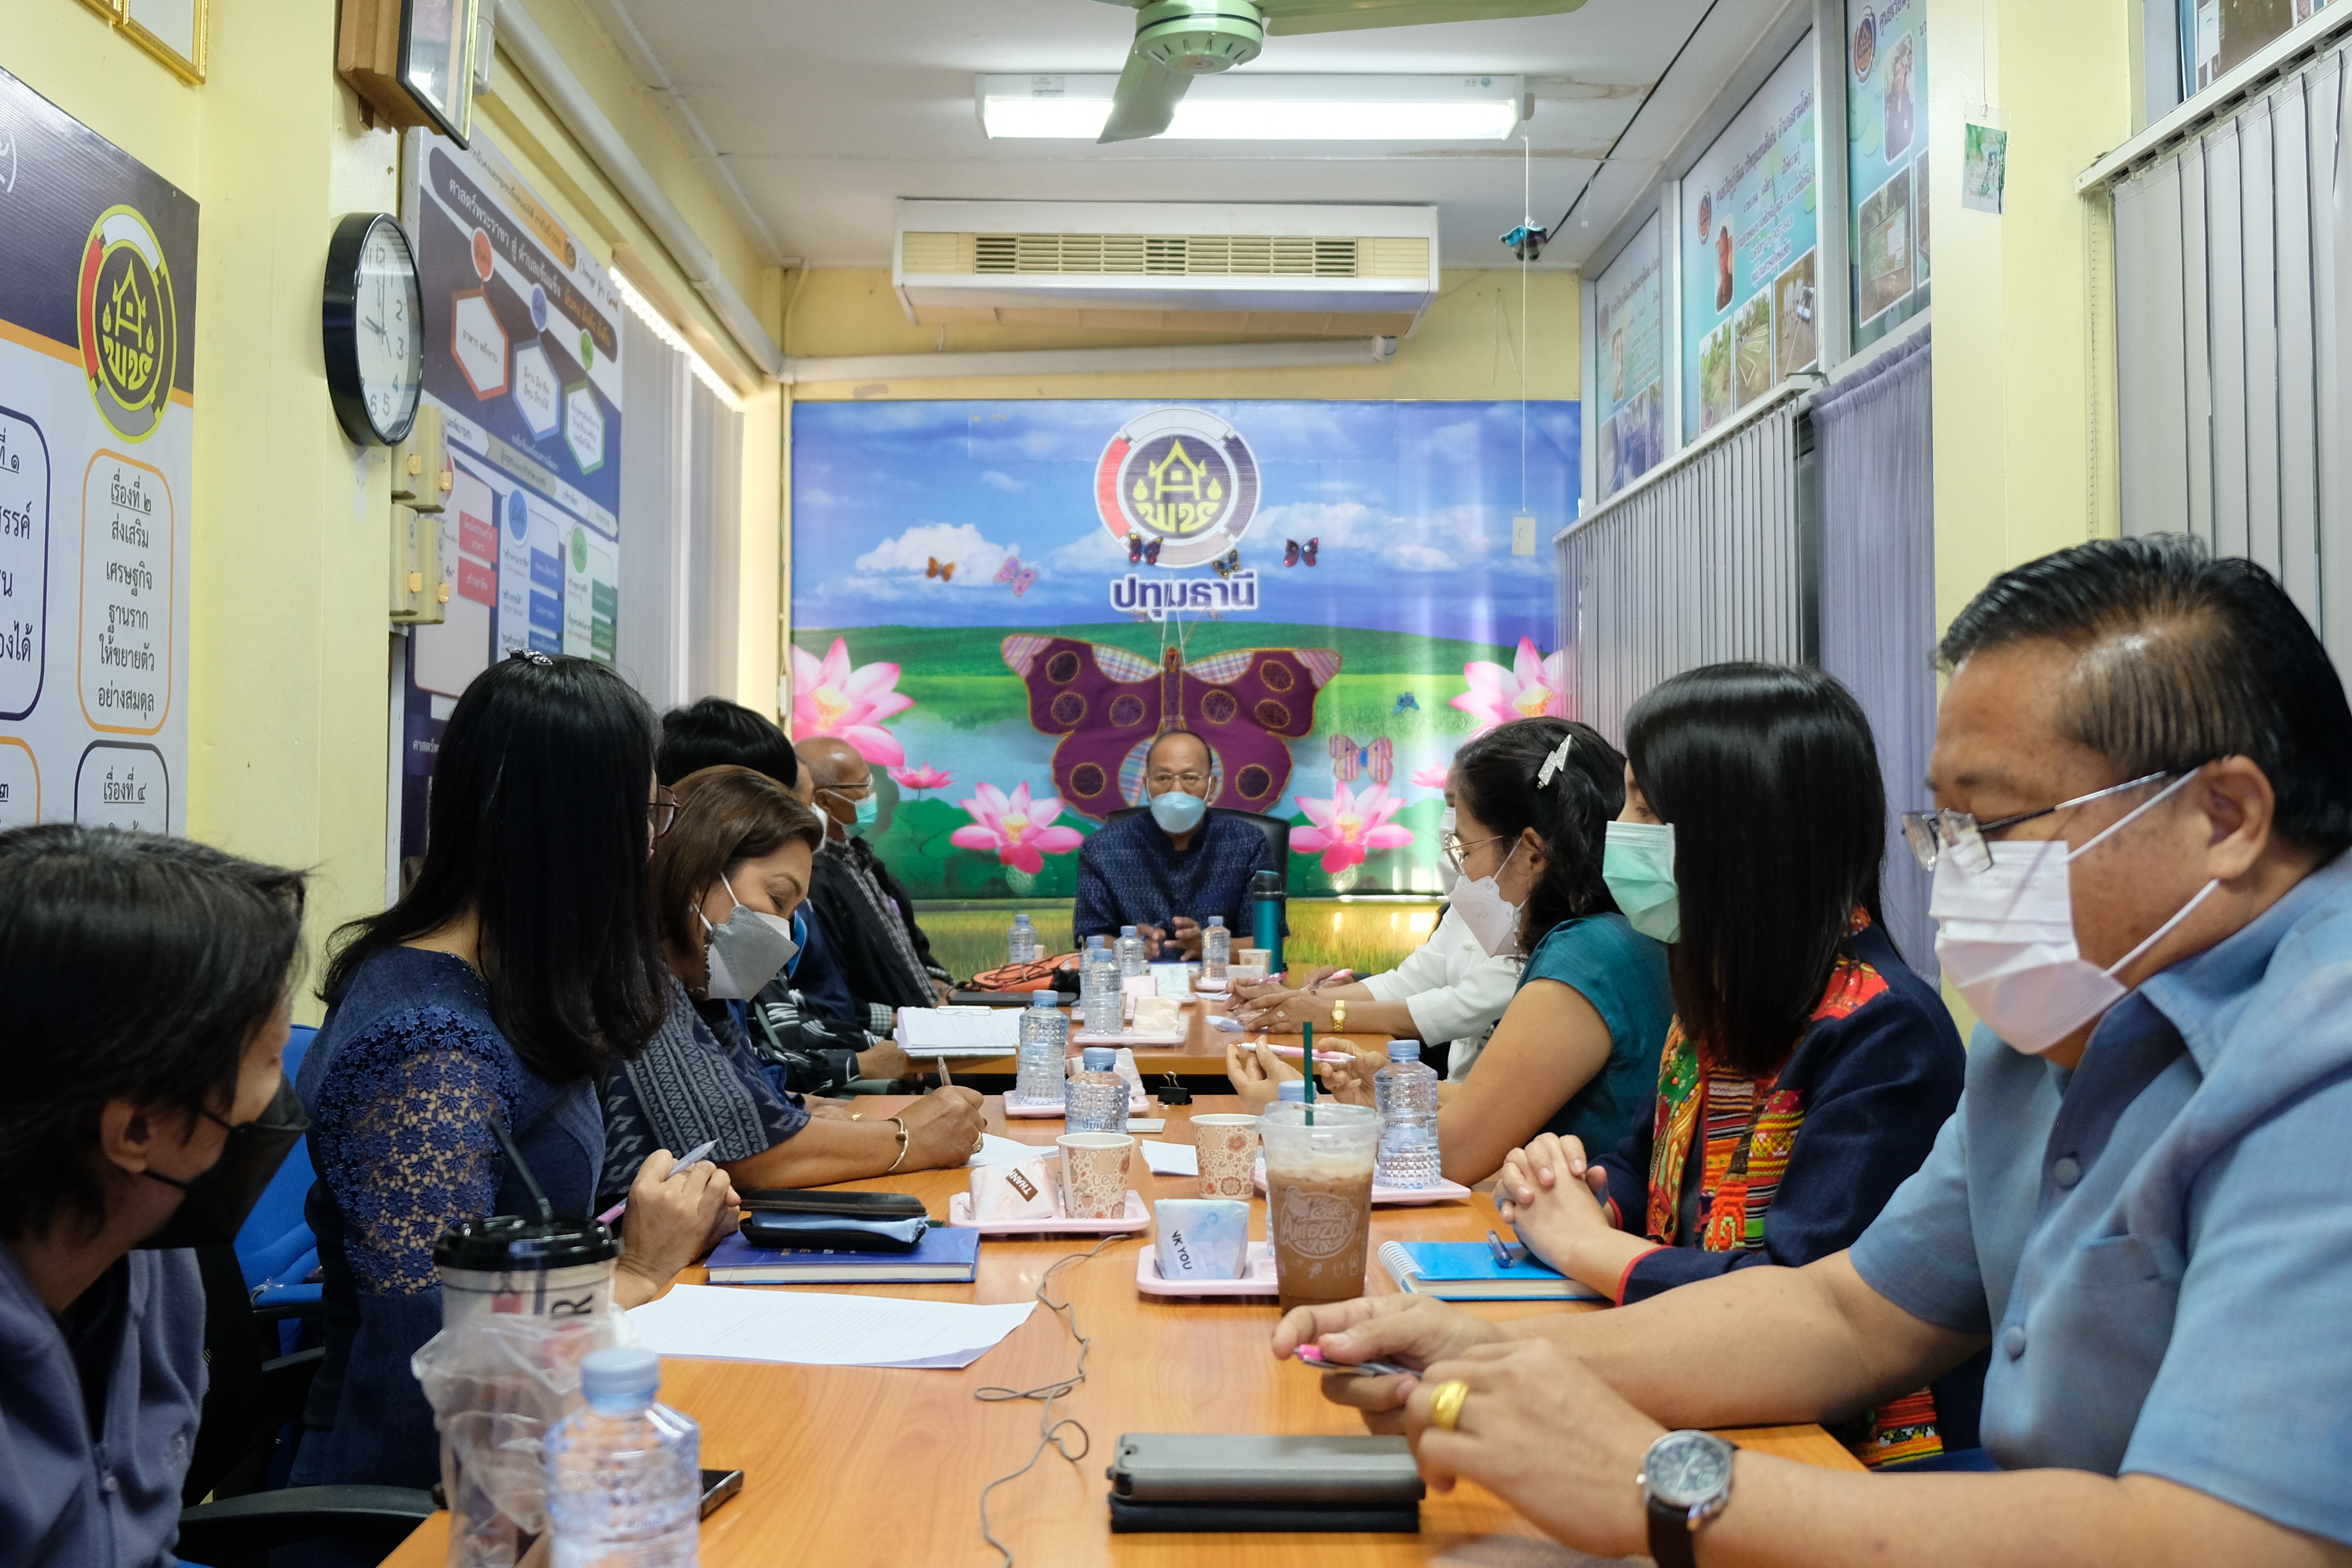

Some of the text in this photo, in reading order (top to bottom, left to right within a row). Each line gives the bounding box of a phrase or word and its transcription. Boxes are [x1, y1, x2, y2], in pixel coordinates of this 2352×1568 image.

[449, 178, 509, 247] ศาสตร์พระราชา
[519, 244, 561, 297] ตำบลเข้มแข็ง
[396, 299, 403, 321] 2
[396, 336, 404, 360] 3
[392, 373, 398, 393] 4
[370, 393, 377, 416] 6
[383, 393, 390, 416] 5
[111, 468, 151, 512] เรื่องที่ ๒
[0, 501, 32, 539] รรค์
[111, 513, 149, 549] ส่งเสริม
[0, 570, 13, 597] น
[106, 560, 152, 596] เศรษฐกิจ
[1113, 573, 1255, 617] ปทุมธานี
[107, 604, 148, 634] ฐานราก
[98, 633, 154, 672] ให้ขยายตัว
[98, 679, 154, 721] อย่างสมดุล
[104, 766, 147, 801] เรื่องที่ ๔
[1202, 1148, 1225, 1159] tea
[1091, 1174, 1117, 1187] tea
[1177, 1247, 1193, 1270] YOU
